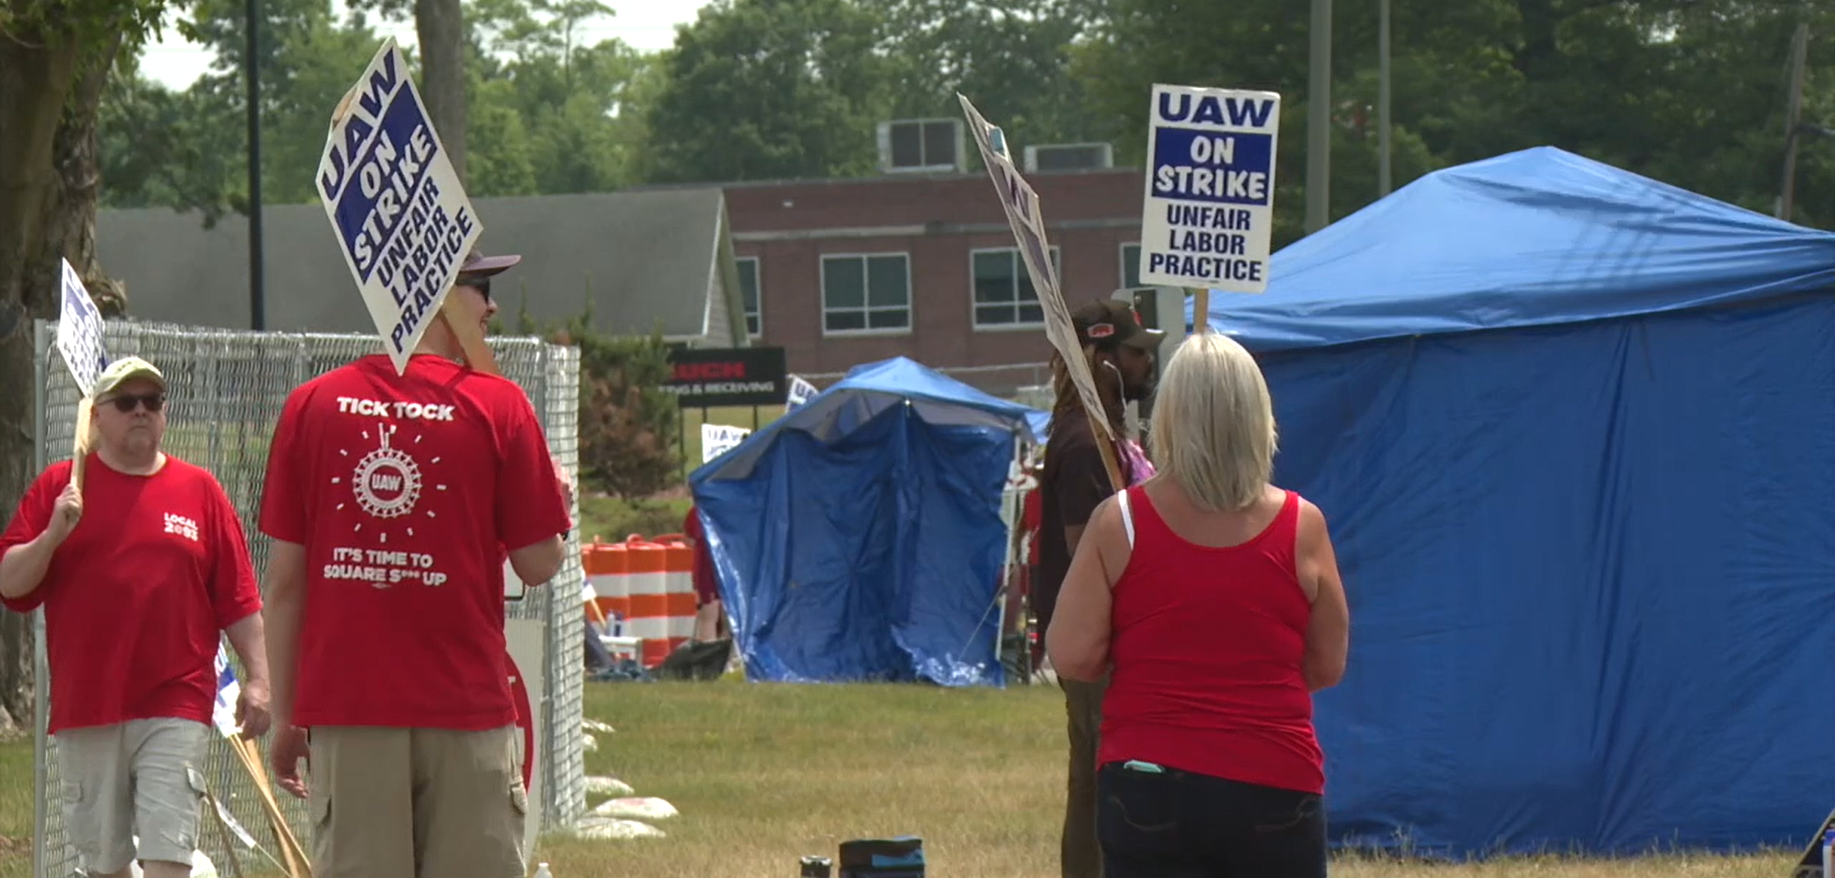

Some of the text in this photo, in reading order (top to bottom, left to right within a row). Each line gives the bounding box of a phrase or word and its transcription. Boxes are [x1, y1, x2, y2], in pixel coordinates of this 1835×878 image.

[322, 47, 397, 200] UAW
[1159, 92, 1274, 127] UAW
[1190, 135, 1235, 165] ON
[360, 130, 397, 199] ON
[1155, 164, 1266, 199] STRIKE
[354, 123, 433, 269] STRIKE
[377, 175, 439, 287] UNFAIR
[1167, 204, 1250, 230] UNFAIR
[1169, 229, 1245, 255] LABOR
[391, 205, 448, 309] LABOR
[1149, 253, 1262, 281] PRACTICE
[390, 206, 472, 353] PRACTICE
[671, 362, 745, 380] UCH
[704, 381, 774, 394] RECEIVING
[336, 396, 456, 421] TICK TOCK
[371, 473, 401, 491] UAW
[164, 512, 198, 530] LOCAL
[333, 547, 433, 568] IT'S TIME TO
[324, 564, 386, 581] SQUARE
[422, 571, 447, 586] UP
